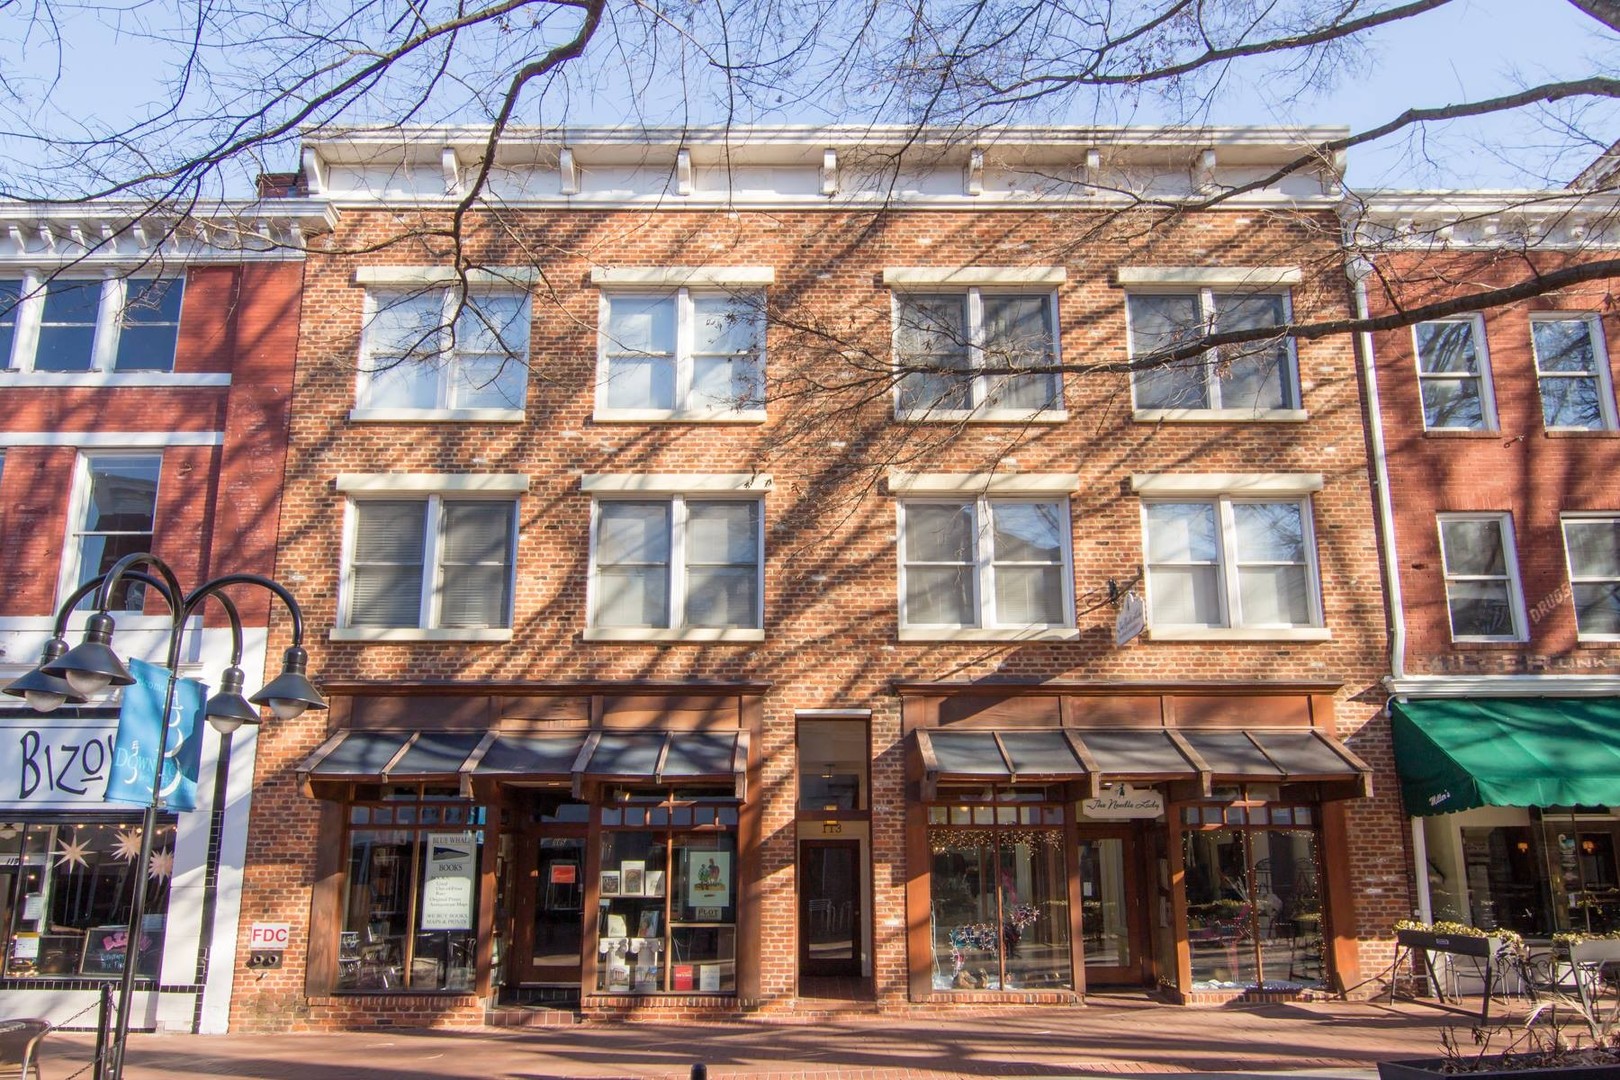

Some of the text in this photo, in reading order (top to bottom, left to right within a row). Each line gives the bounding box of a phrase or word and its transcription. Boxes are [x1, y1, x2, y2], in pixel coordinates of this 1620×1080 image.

[1530, 583, 1571, 624] DRUGS
[1086, 799, 1160, 810] The Needle Lady
[252, 928, 288, 942] FDC
